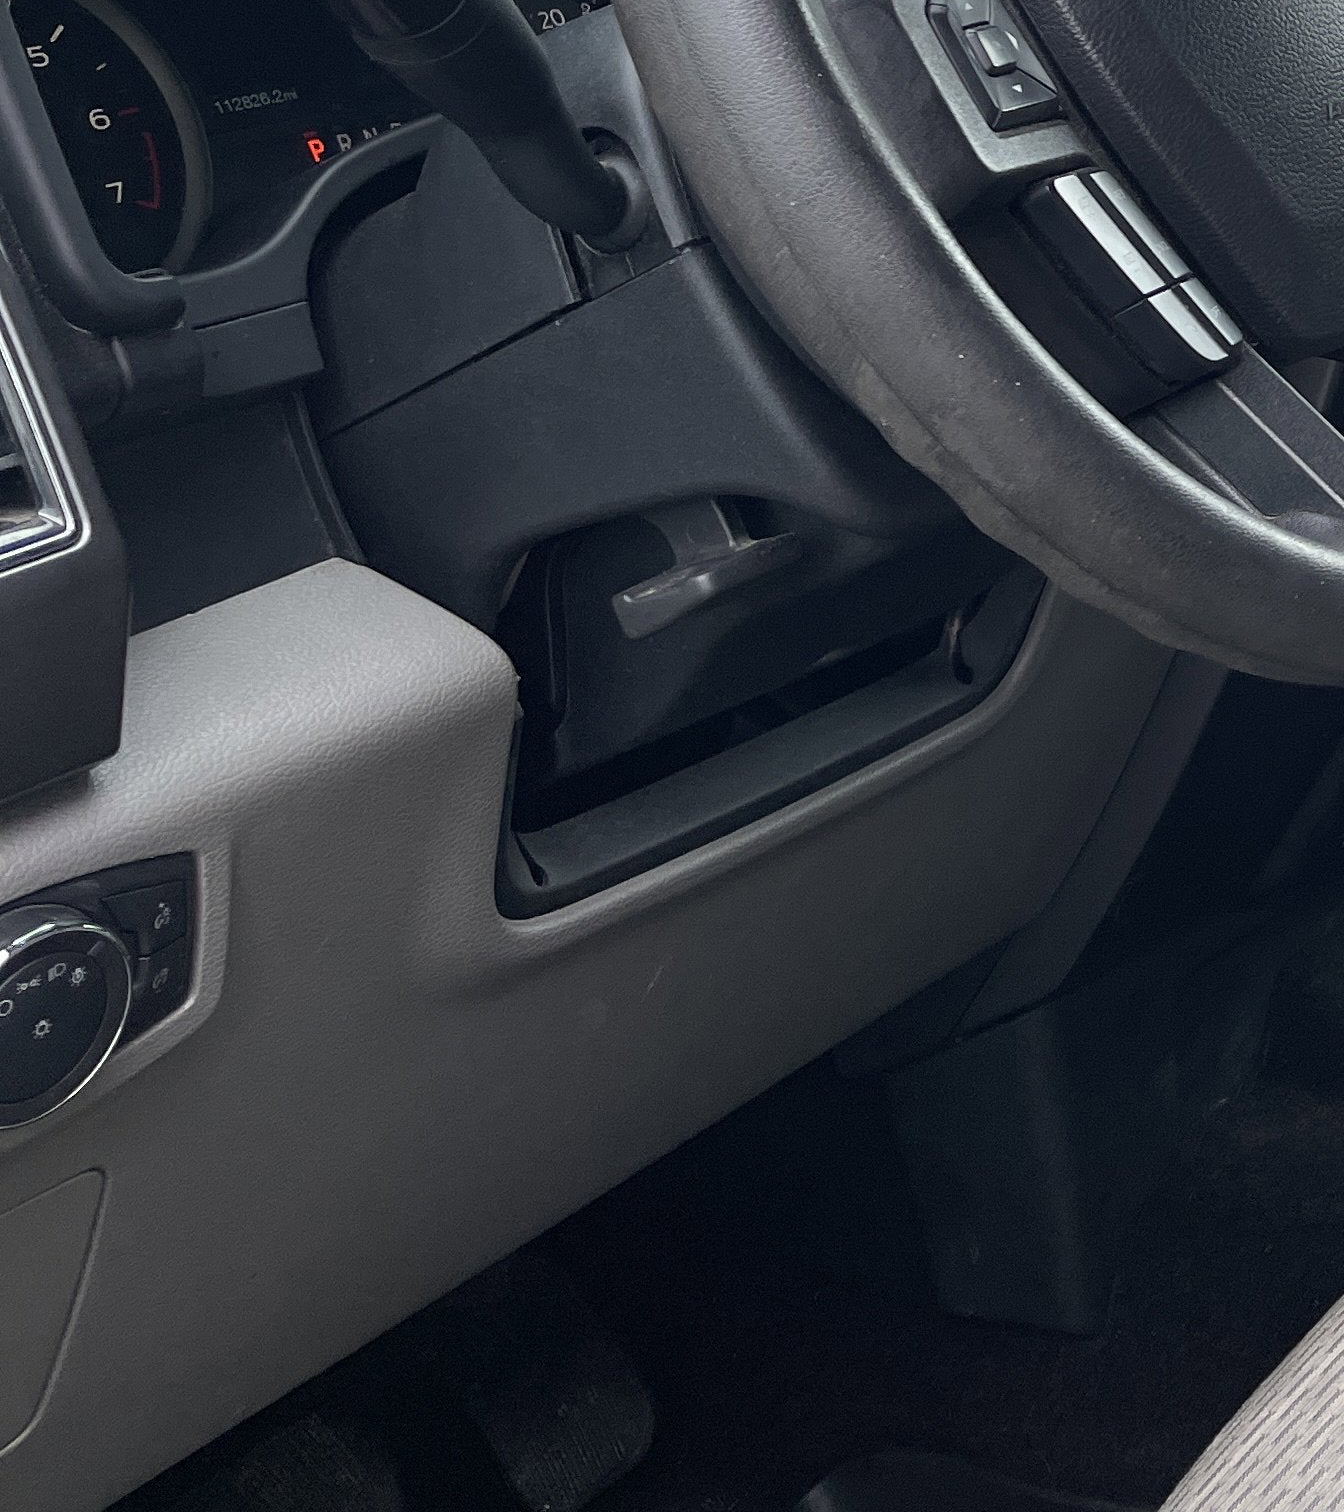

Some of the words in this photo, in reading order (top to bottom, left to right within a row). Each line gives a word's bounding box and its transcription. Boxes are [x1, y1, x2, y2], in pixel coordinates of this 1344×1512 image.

[537, 8, 566, 30] 20
[26, 45, 51, 69] 5
[88, 107, 113, 131] 6
[306, 136, 326, 164] P
[104, 180, 124, 204] 7
